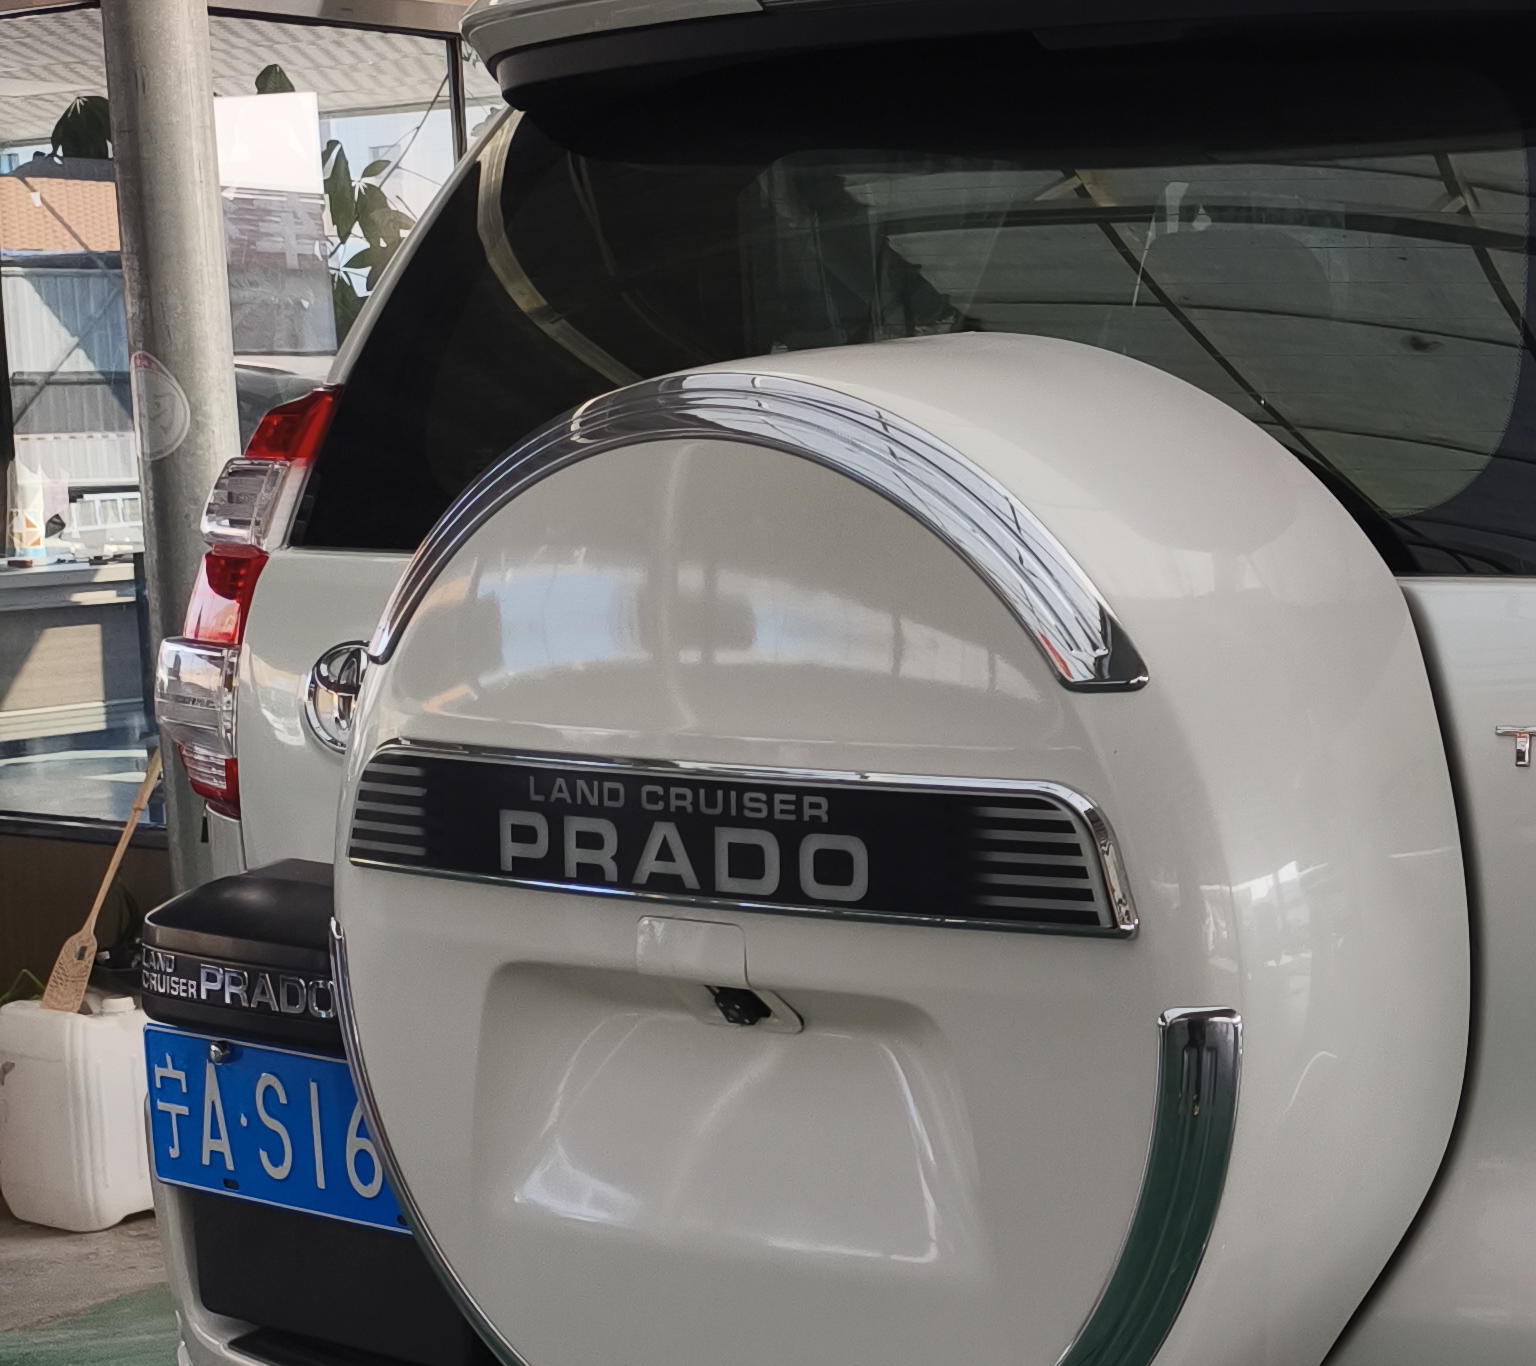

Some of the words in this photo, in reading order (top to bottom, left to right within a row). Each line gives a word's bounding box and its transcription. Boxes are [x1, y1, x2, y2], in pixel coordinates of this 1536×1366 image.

[528, 775, 625, 808] LAND
[640, 784, 829, 823] CRUISER
[498, 808, 869, 902] PRADO
[141, 947, 177, 974] LAND
[141, 969, 198, 1000] CRUISER
[199, 963, 338, 1019] PRADO
